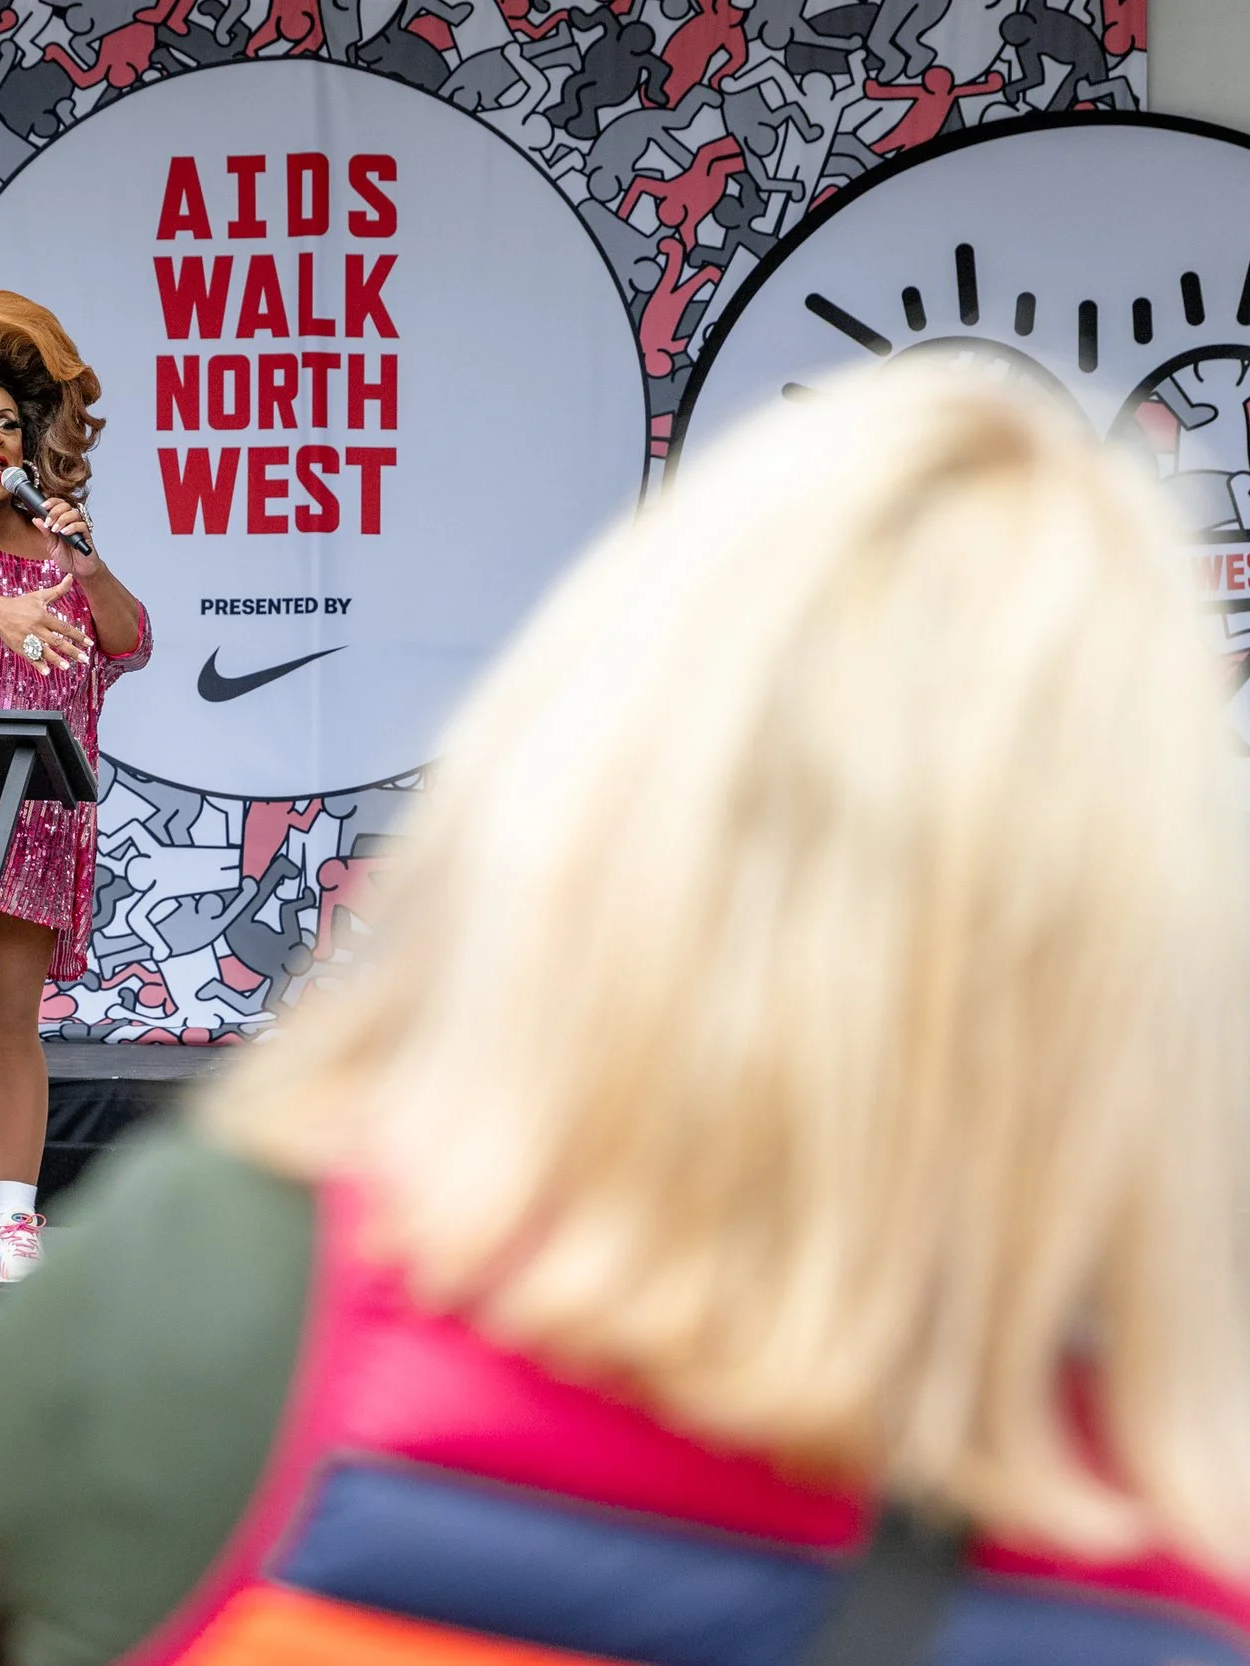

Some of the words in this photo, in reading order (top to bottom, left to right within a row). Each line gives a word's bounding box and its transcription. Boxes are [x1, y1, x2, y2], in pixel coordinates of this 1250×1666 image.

[156, 152, 397, 240] AIDS
[153, 252, 400, 339] WALK
[156, 352, 398, 431] NORTH
[157, 445, 397, 535] WEST
[200, 597, 318, 615] PRESENTED
[324, 597, 352, 615] BY
